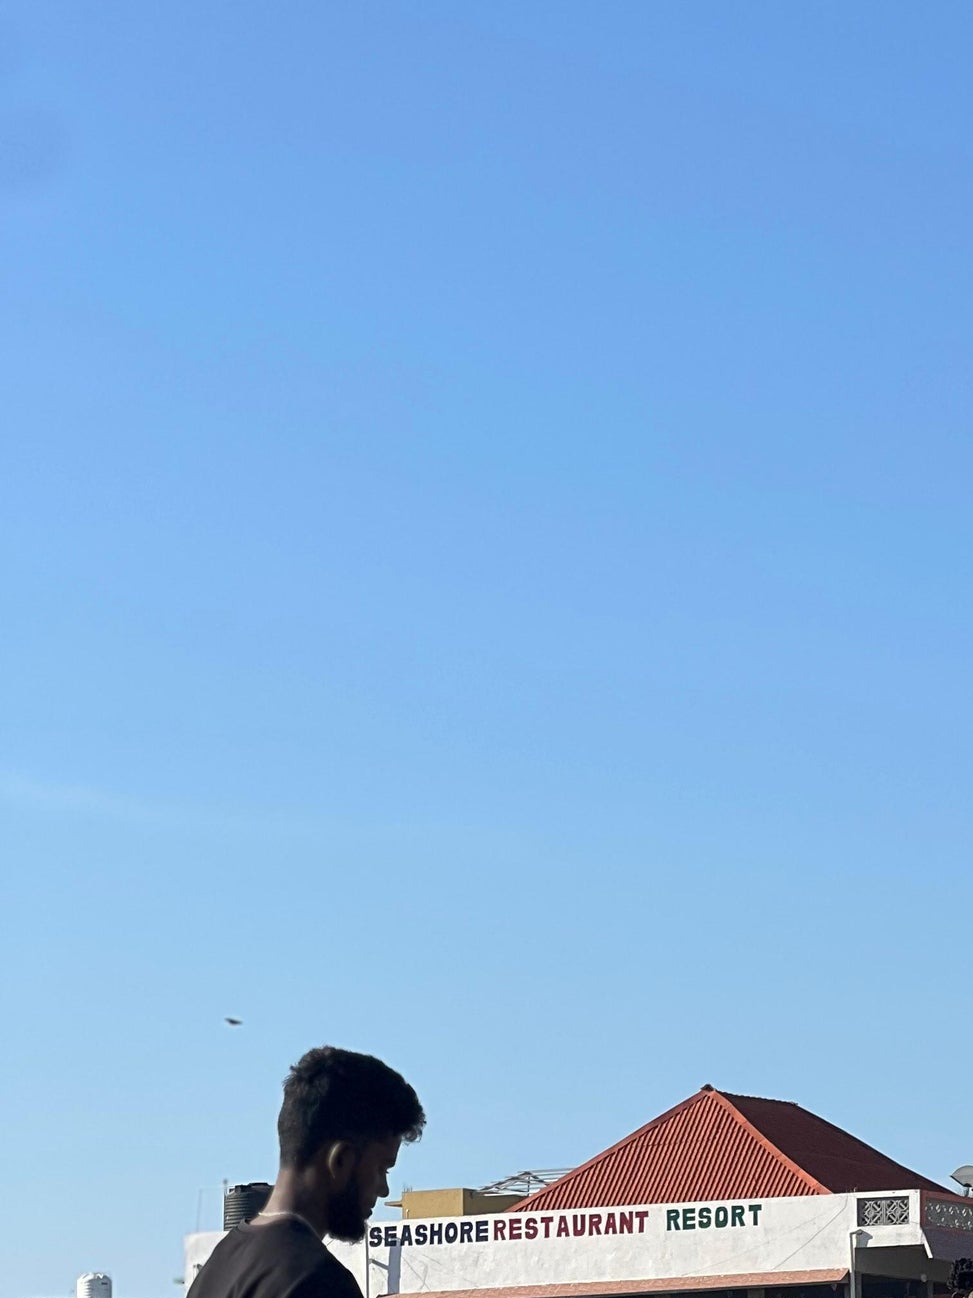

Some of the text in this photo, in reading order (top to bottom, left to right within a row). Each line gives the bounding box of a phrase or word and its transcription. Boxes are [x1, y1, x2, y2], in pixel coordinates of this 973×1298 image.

[369, 1204, 762, 1248] SEASHORE RESTAURANT RESORT
